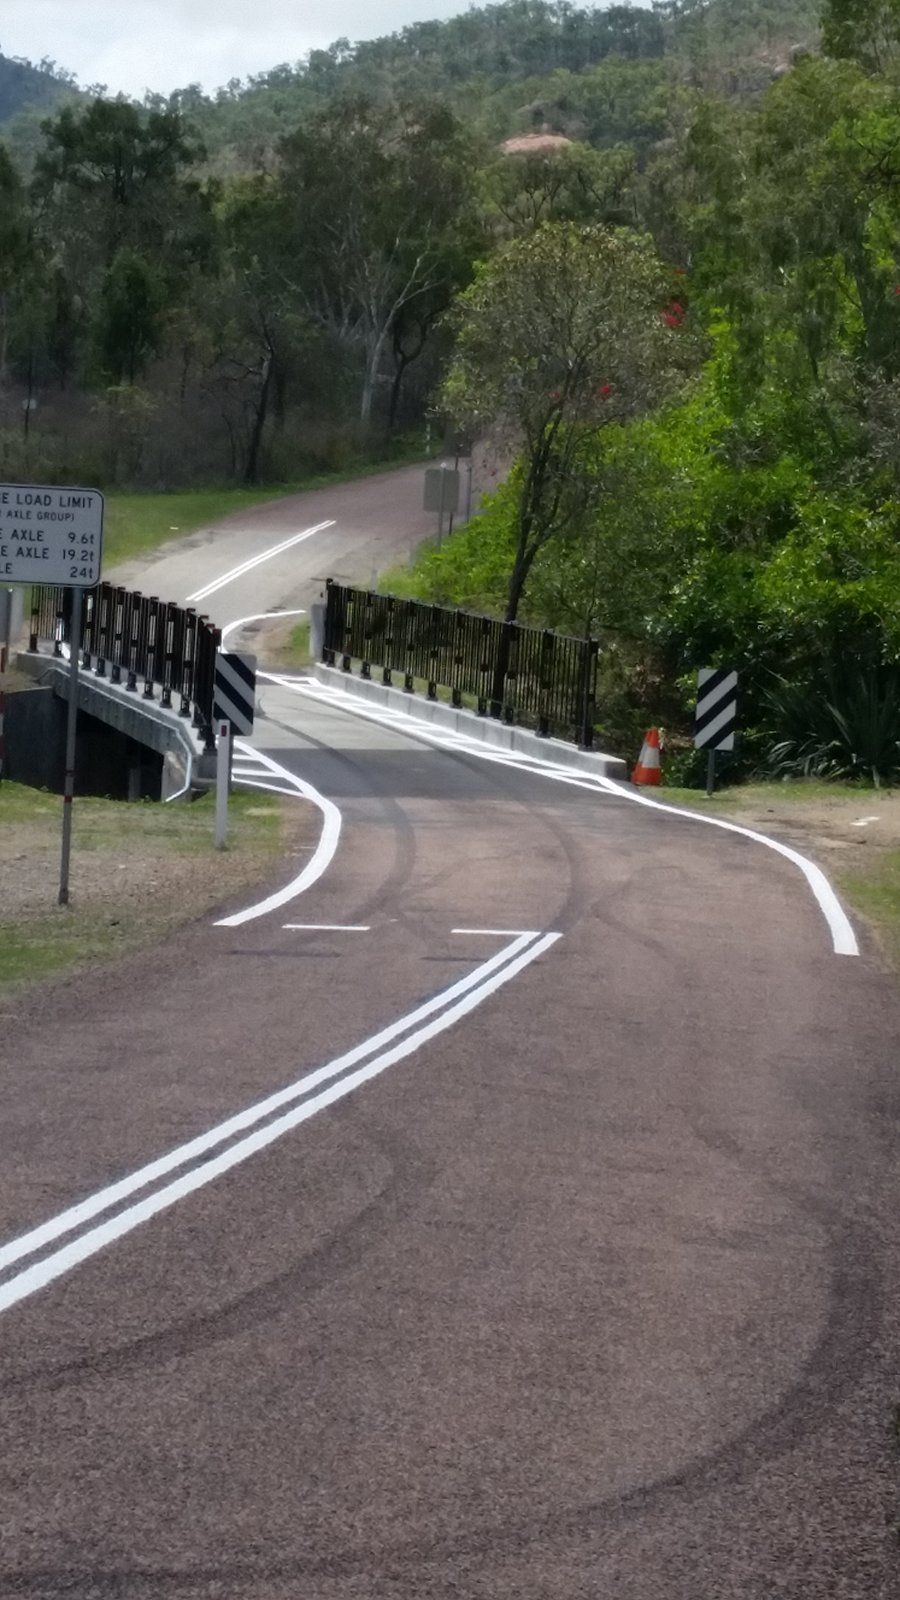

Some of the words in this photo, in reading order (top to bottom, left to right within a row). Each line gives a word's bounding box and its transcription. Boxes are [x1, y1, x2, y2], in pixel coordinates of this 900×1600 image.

[16, 494, 52, 507] LOAD
[59, 496, 94, 509] LIMIT
[6, 510, 32, 520] AXLE
[10, 529, 44, 542] AXLE
[67, 532, 95, 545] 9.6t
[15, 547, 49, 559] AXLE
[62, 549, 94, 562] 19.2t
[69, 566, 94, 579] 24t
